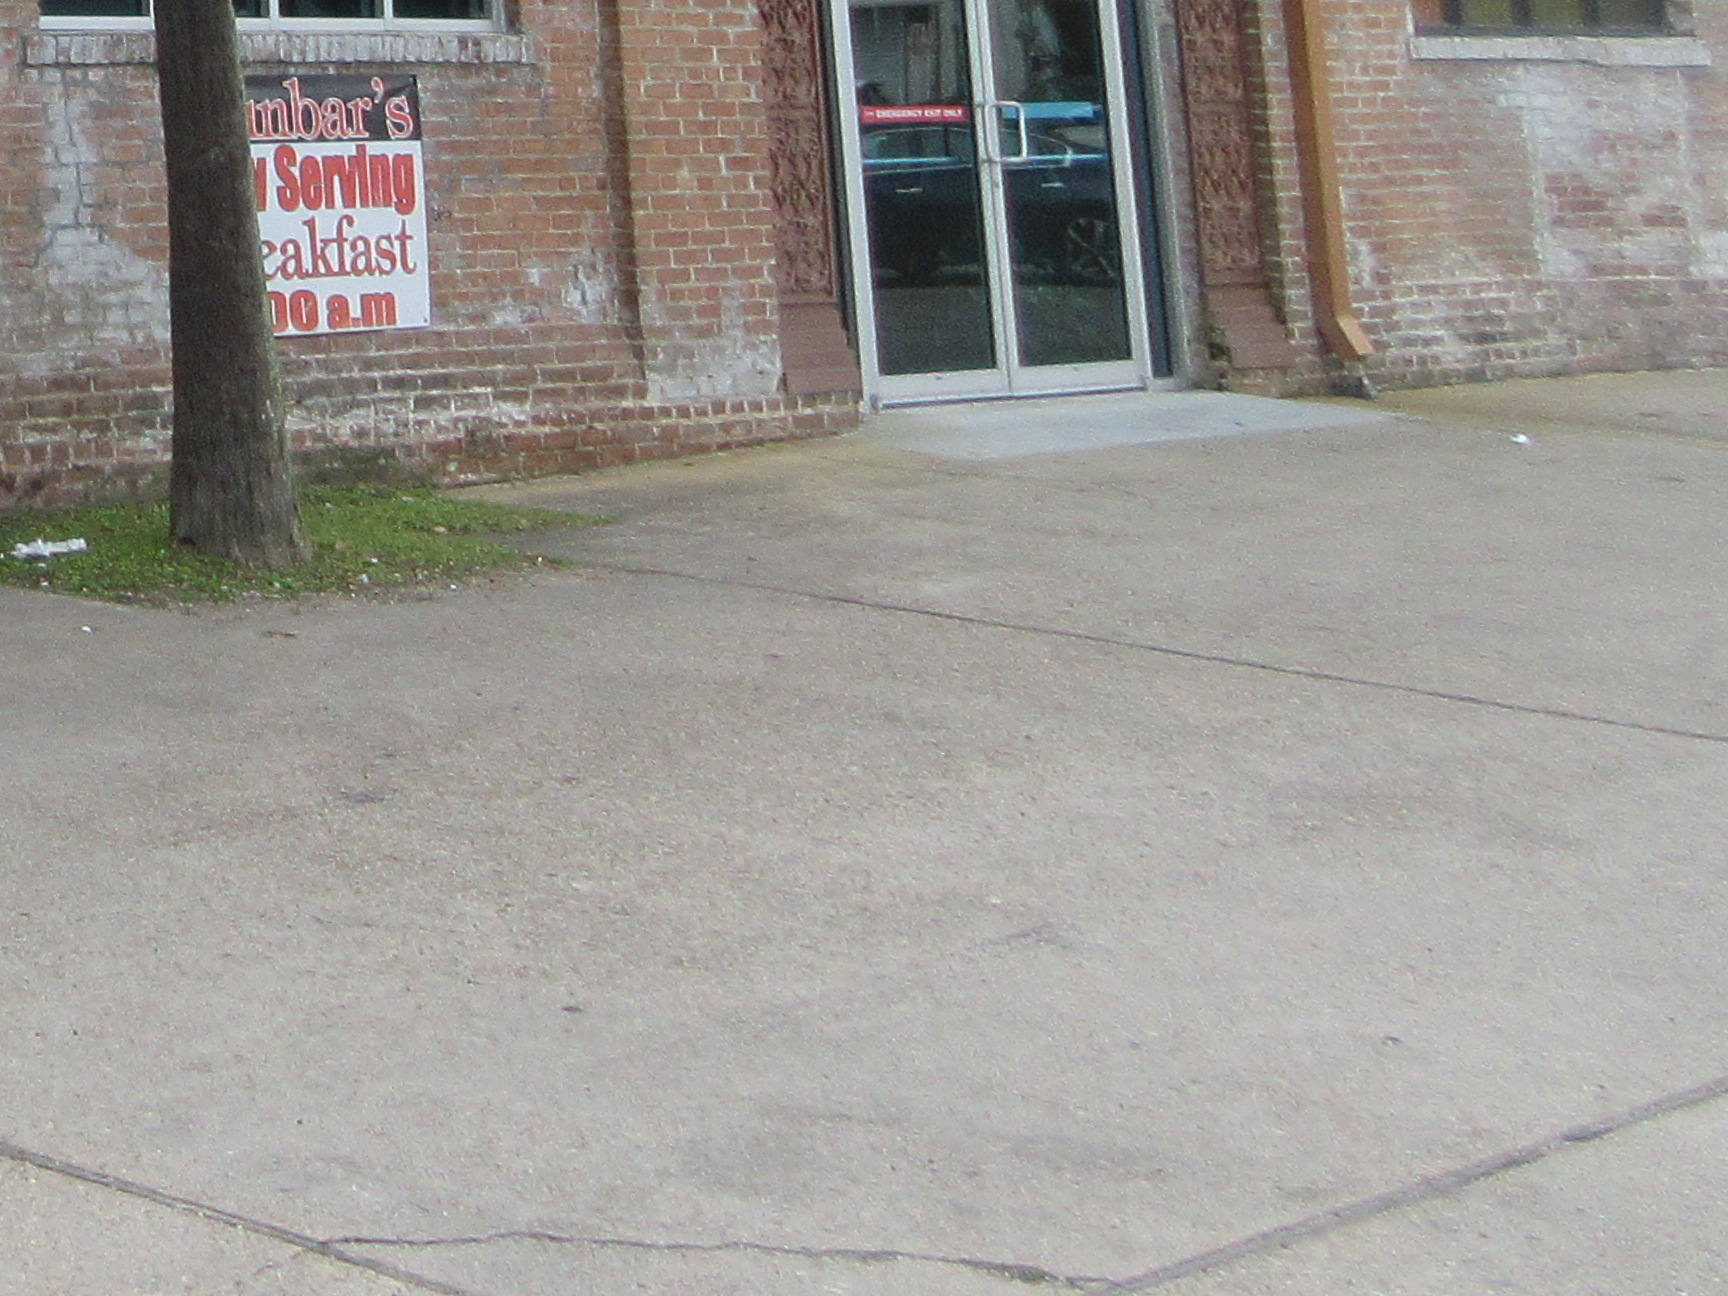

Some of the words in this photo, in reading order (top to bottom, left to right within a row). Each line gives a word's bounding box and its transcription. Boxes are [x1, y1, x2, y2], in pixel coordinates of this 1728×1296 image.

[246, 76, 414, 140] nbar's
[273, 144, 416, 215] Serving
[260, 214, 417, 281] eakfast
